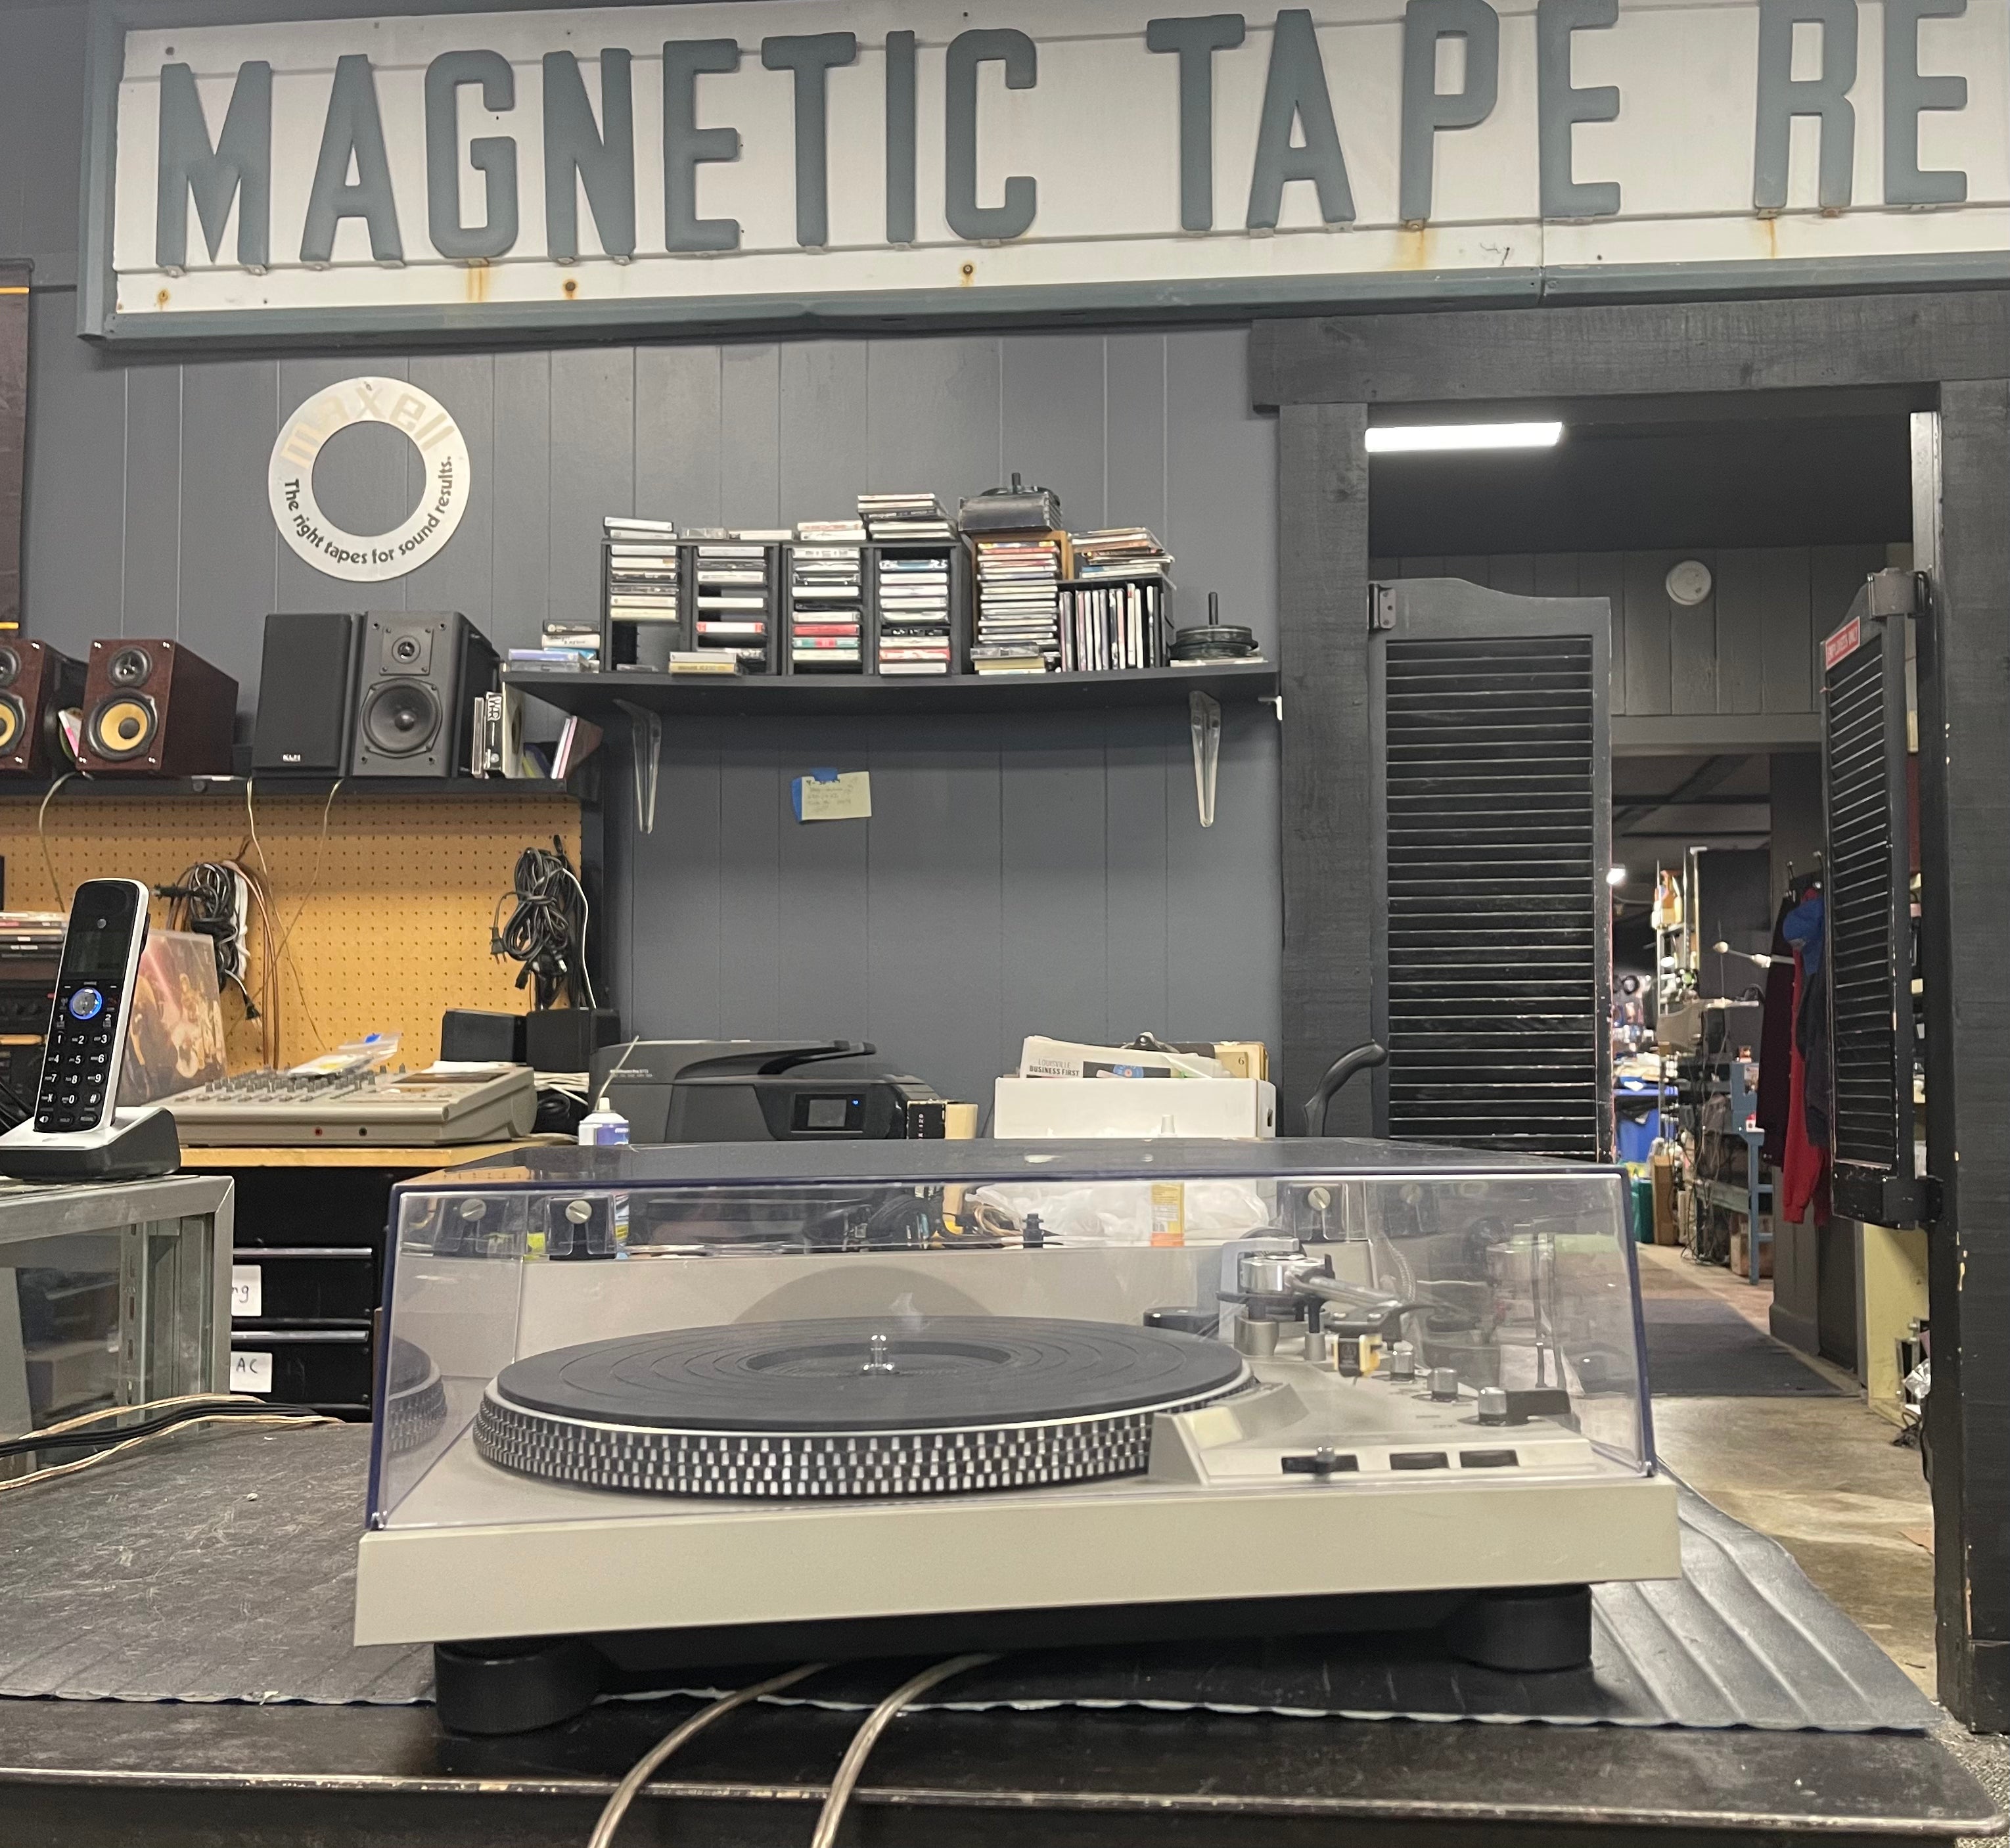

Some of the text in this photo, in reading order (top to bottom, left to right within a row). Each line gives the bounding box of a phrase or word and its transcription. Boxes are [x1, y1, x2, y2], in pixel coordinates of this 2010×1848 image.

[156, 0, 1968, 268] MAGNETIC TAPE RE
[279, 386, 455, 469] maxell
[284, 478, 300, 511] The
[293, 517, 325, 548] right
[324, 540, 368, 563] tapes
[372, 547, 394, 564] for
[398, 513, 440, 556] sound
[57, 1034, 108, 1044] 1 2 3
[54, 1054, 104, 1064] 4 5 6
[1038, 1058, 1072, 1069] LOUISVILLE
[1029, 1065, 1061, 1075] BUSINESS
[51, 1074, 101, 1084] 7 8 9
[236, 1357, 258, 1374] AC
